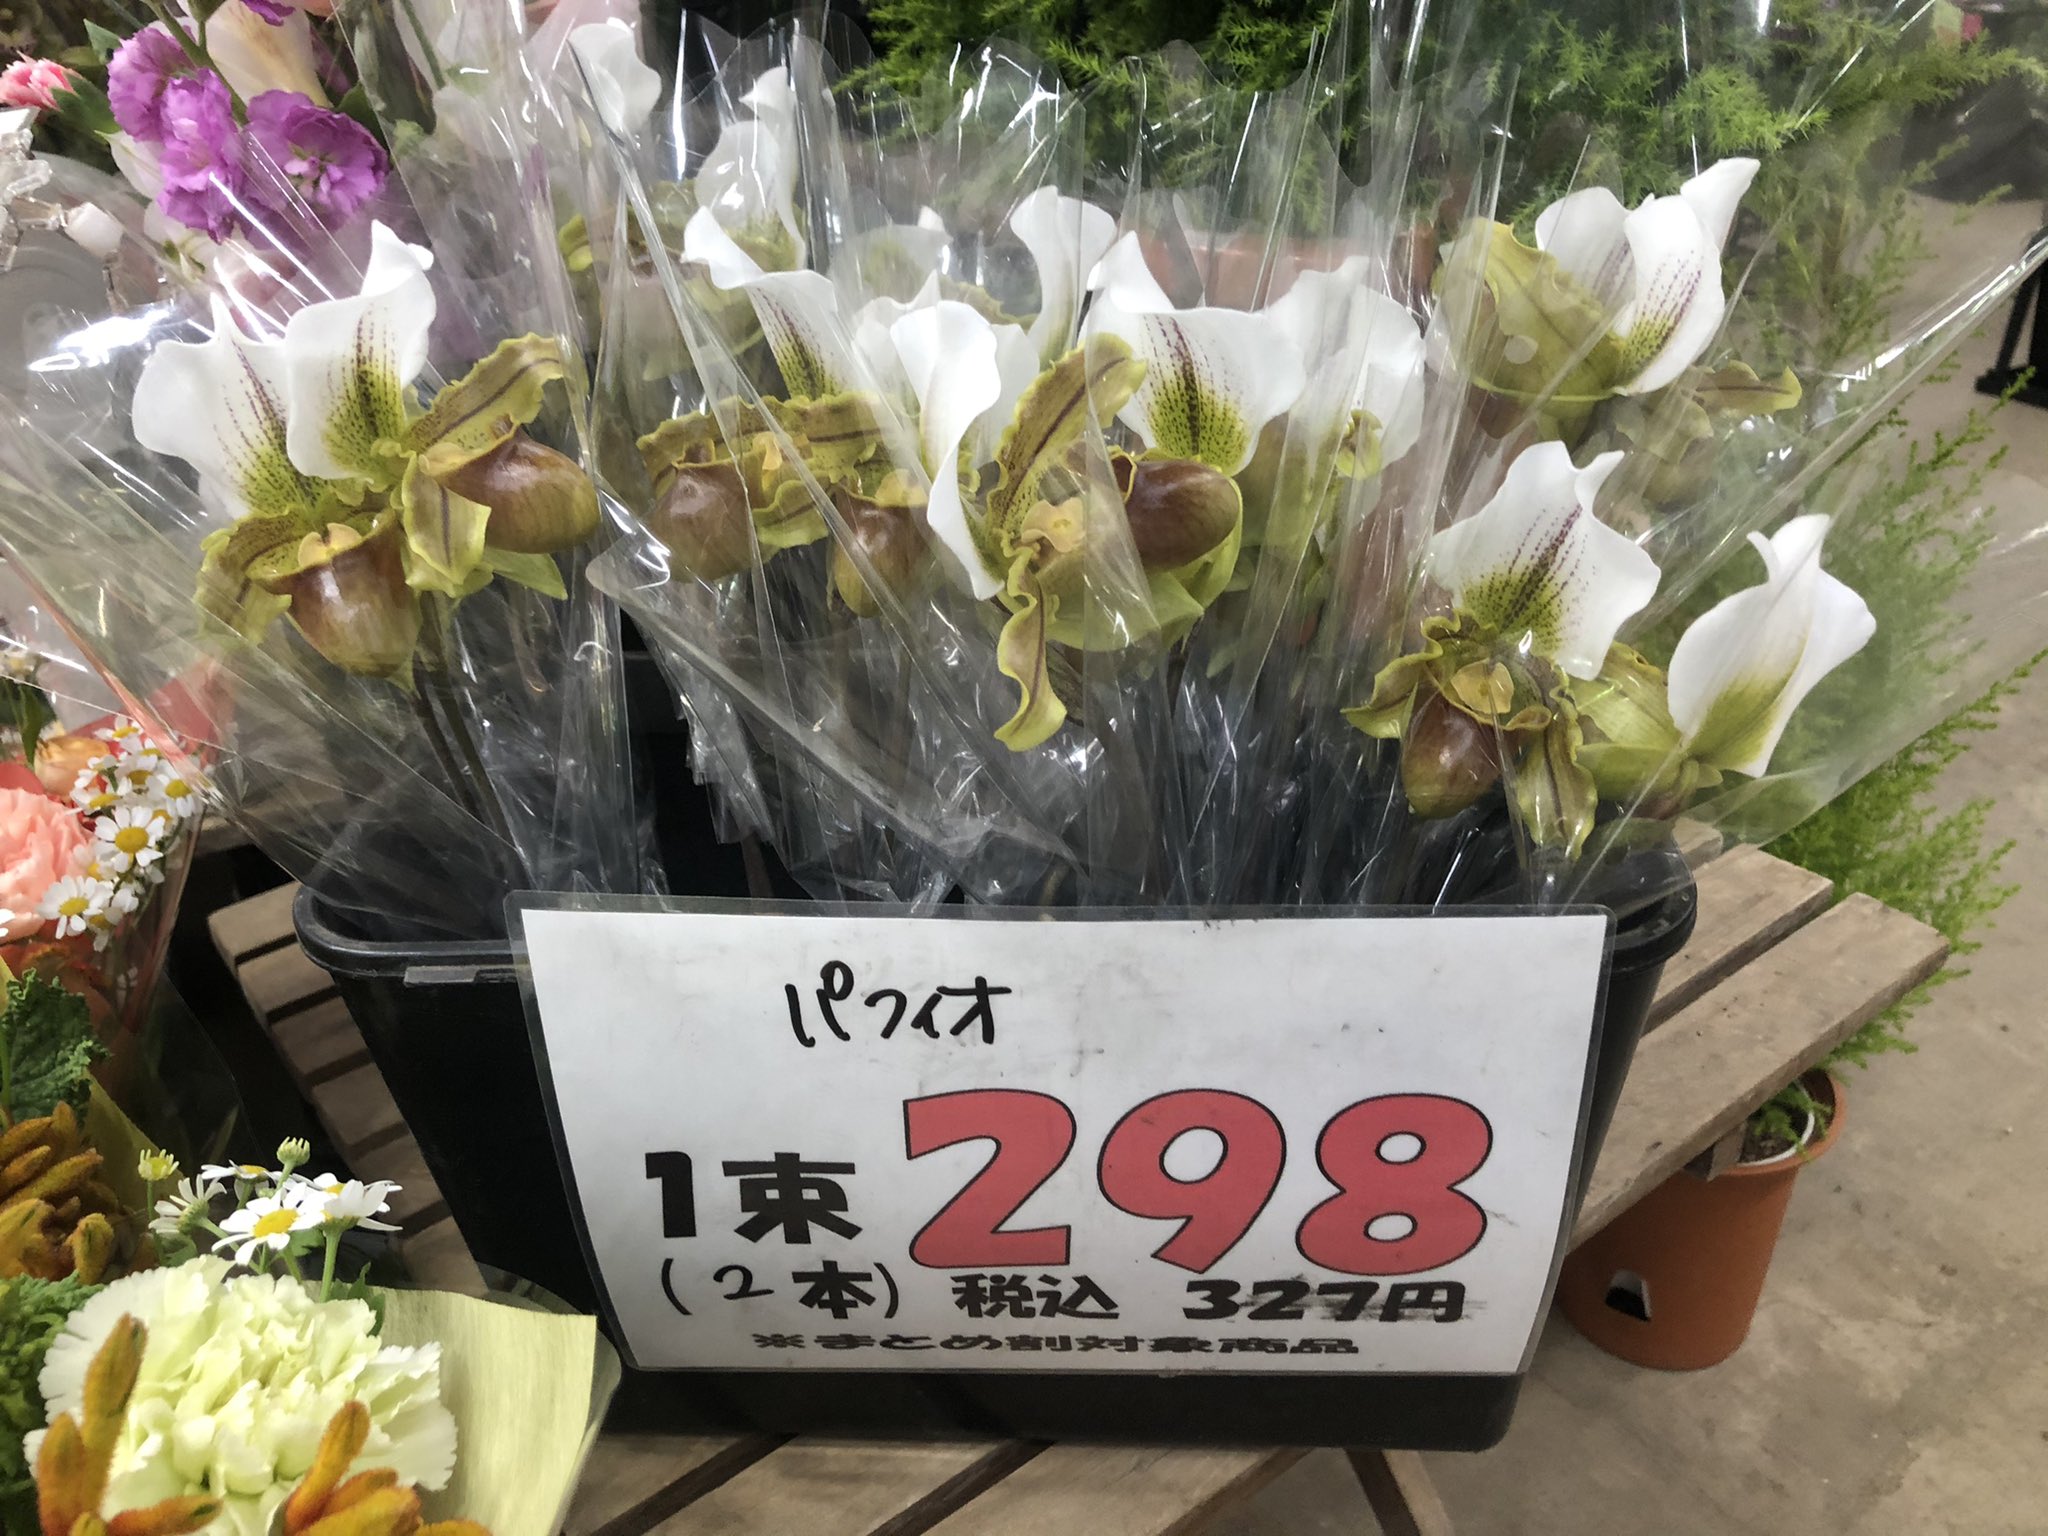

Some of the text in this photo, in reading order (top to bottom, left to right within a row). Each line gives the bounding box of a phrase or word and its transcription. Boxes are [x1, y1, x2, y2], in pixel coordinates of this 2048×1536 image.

[785, 960, 1013, 1048] パフィオ
[904, 1089, 1492, 1274] 298
[951, 1274, 1120, 1319] 税込
[1182, 1278, 1467, 1323] 327円
